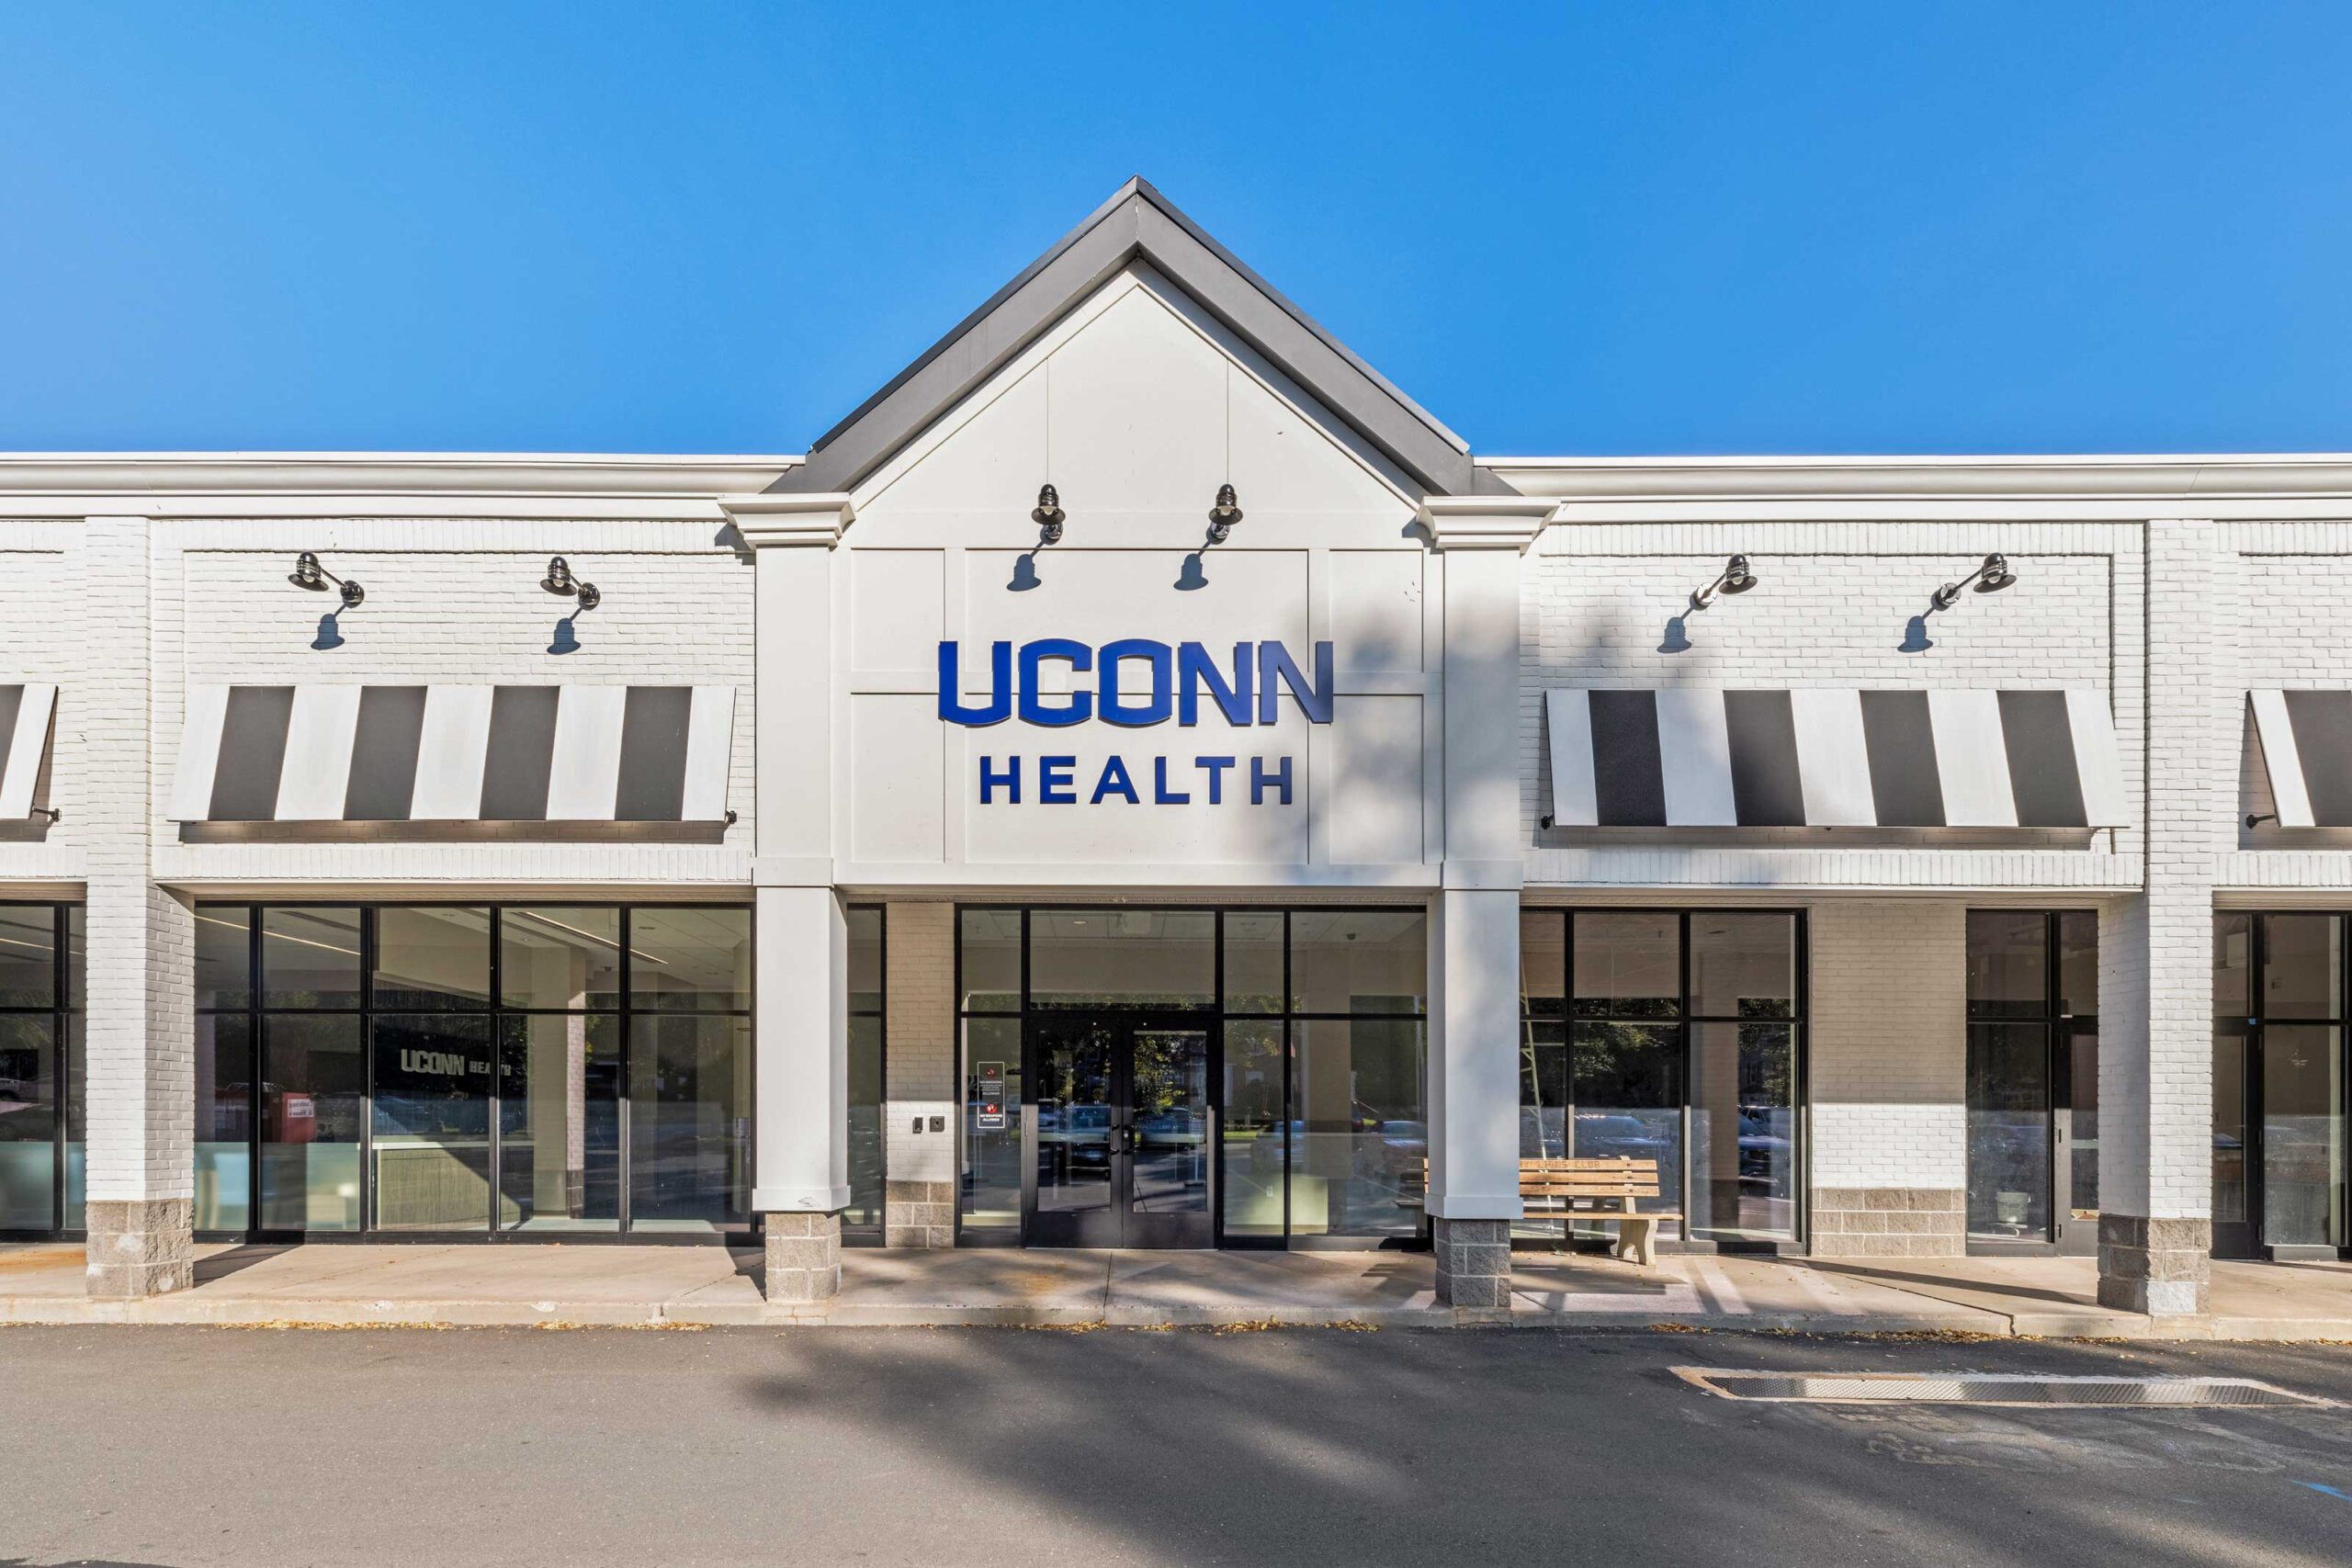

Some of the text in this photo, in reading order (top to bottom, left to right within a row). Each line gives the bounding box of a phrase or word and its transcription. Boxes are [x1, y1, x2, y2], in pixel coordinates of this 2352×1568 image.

[938, 637, 1334, 728] UCONN
[979, 755, 1294, 806] HEALTH
[401, 1048, 512, 1077] UCONN HEATH
[1575, 1160, 1600, 1168] CLUB
